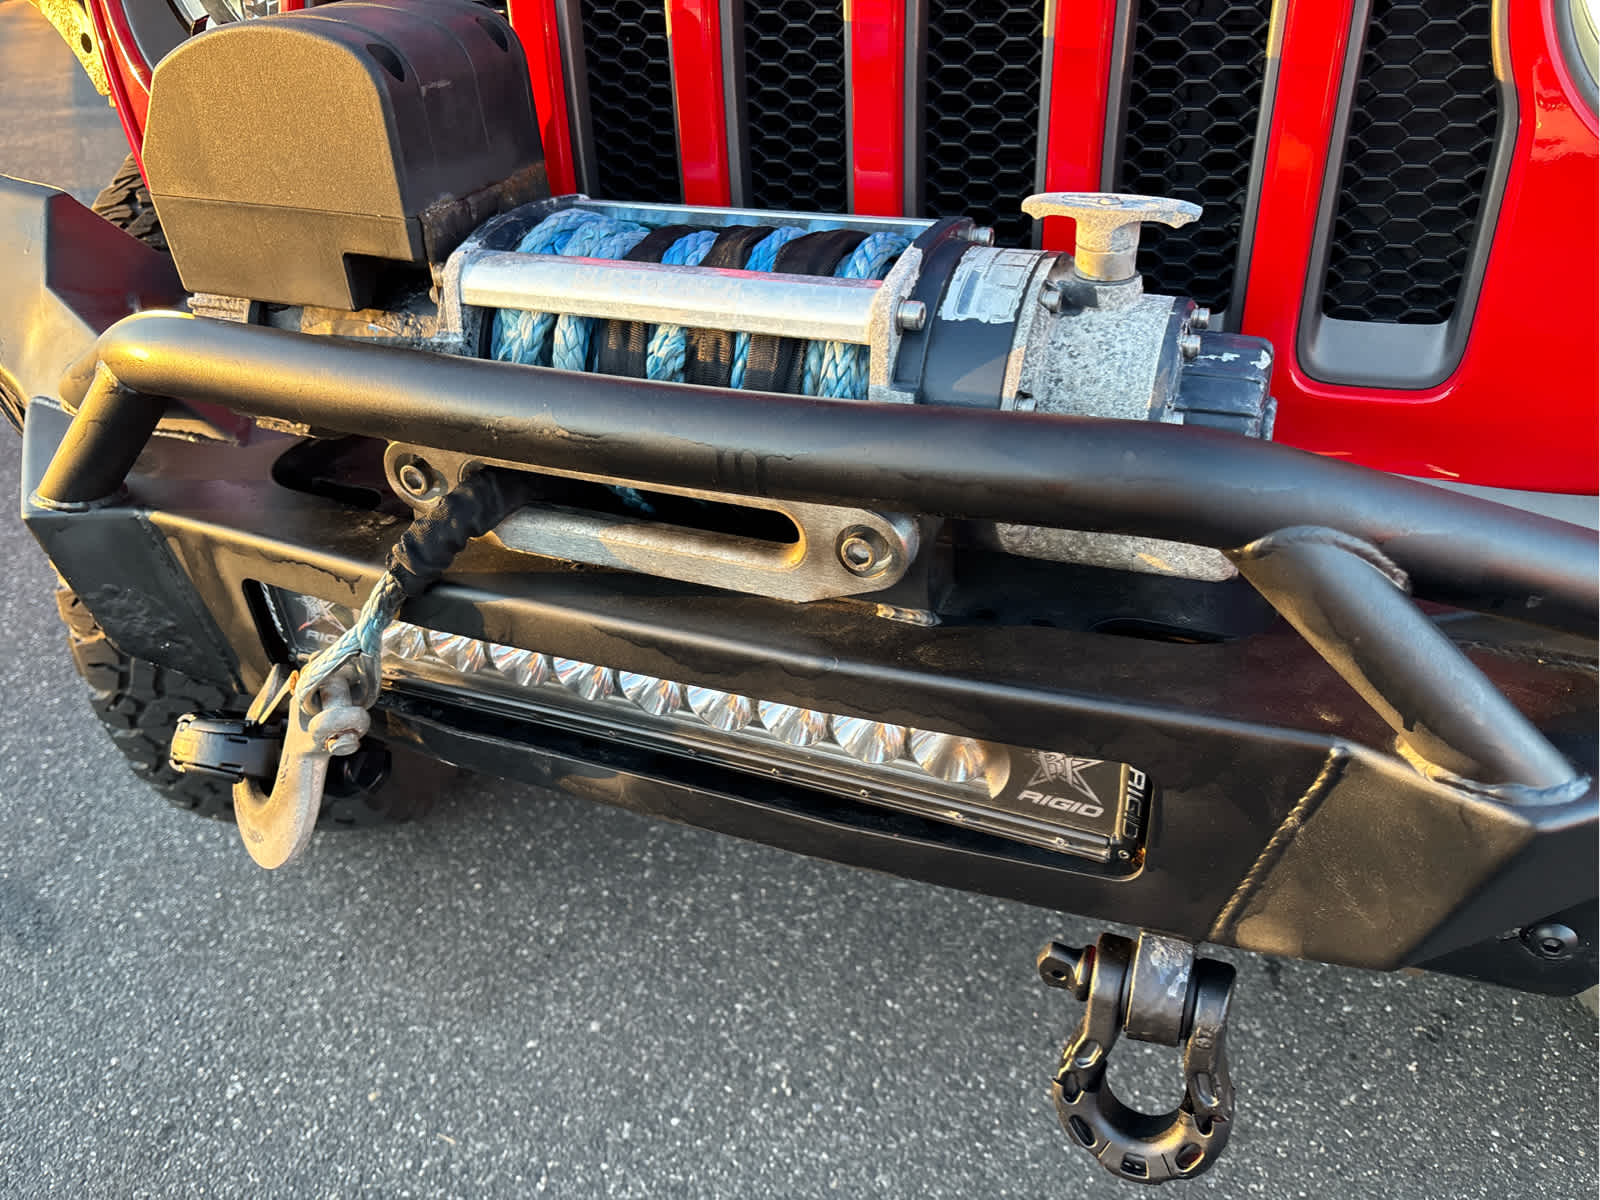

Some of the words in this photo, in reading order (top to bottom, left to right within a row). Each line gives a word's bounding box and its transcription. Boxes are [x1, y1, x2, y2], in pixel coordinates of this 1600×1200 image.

[306, 630, 339, 644] RIG
[1017, 790, 1104, 818] RIGID
[1122, 766, 1146, 839] RIGID
